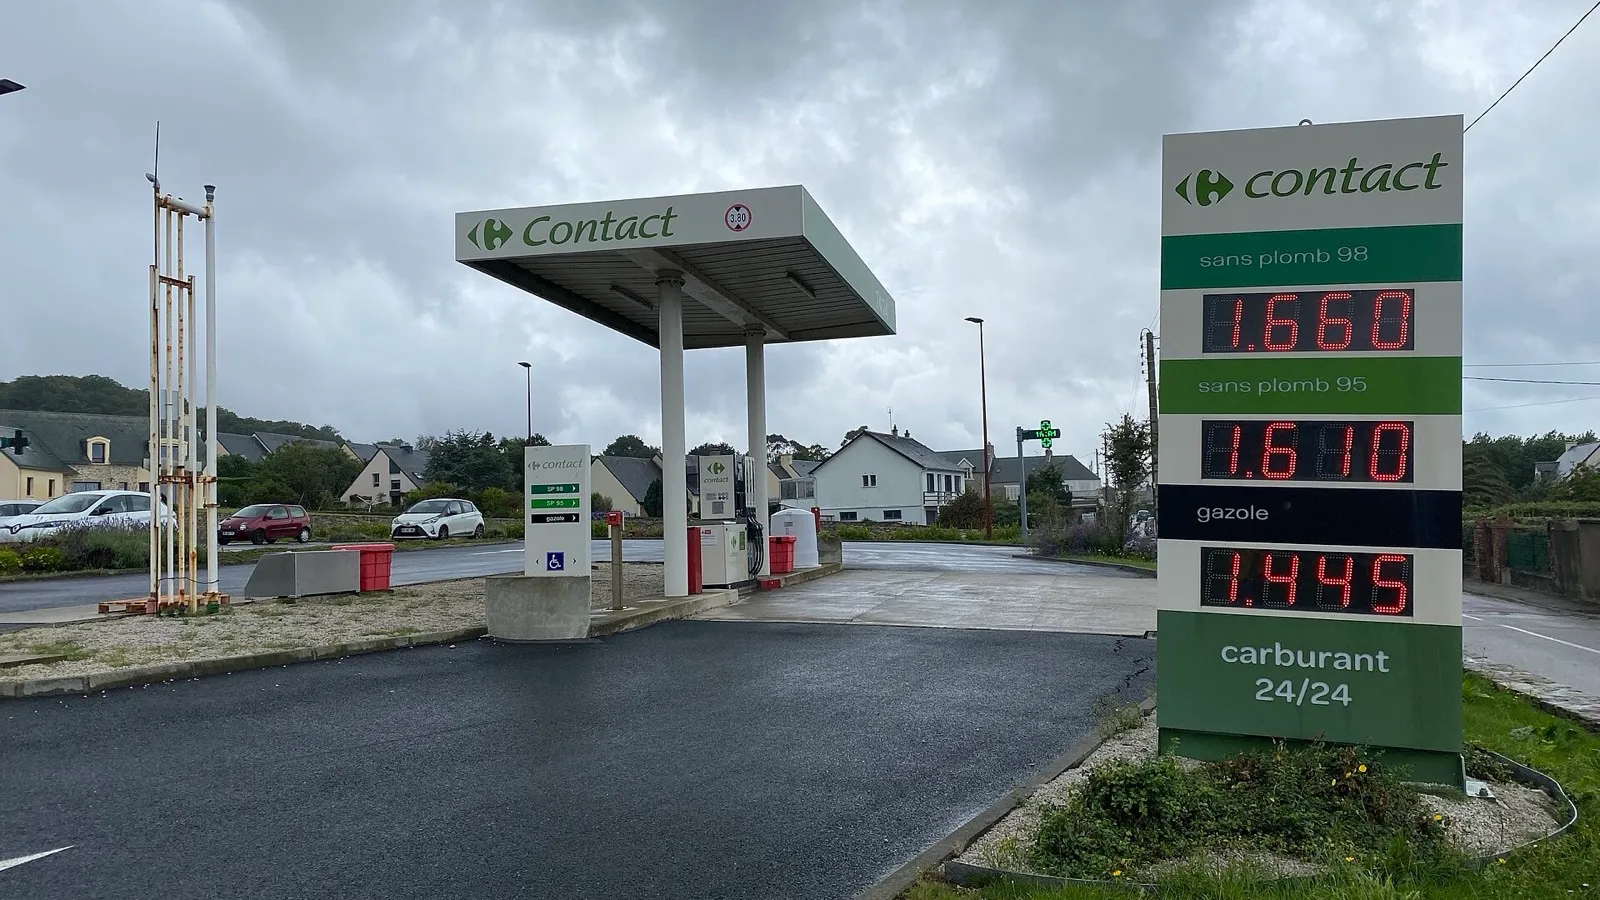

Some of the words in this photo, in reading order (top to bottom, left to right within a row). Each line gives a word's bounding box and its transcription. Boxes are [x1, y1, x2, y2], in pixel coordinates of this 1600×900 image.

[1244, 152, 1448, 199] contact
[523, 206, 678, 247] Contact
[730, 213, 746, 223] 3.80
[1200, 252, 1253, 268] sans
[1259, 248, 1331, 269] plomb
[1337, 245, 1369, 262] 98
[1231, 290, 1411, 350] 1.660
[1198, 378, 1251, 393] sans
[1258, 376, 1330, 396] plomb
[1336, 376, 1368, 392] 95
[542, 459, 583, 470] contact
[1230, 422, 1409, 481] 1.610
[703, 476, 729, 484] contact
[546, 515, 565, 523] gazole
[1197, 504, 1269, 523] gazole
[1230, 552, 1408, 614] 1.445
[1221, 642, 1390, 673] carburant
[1255, 677, 1353, 707] 24/24
